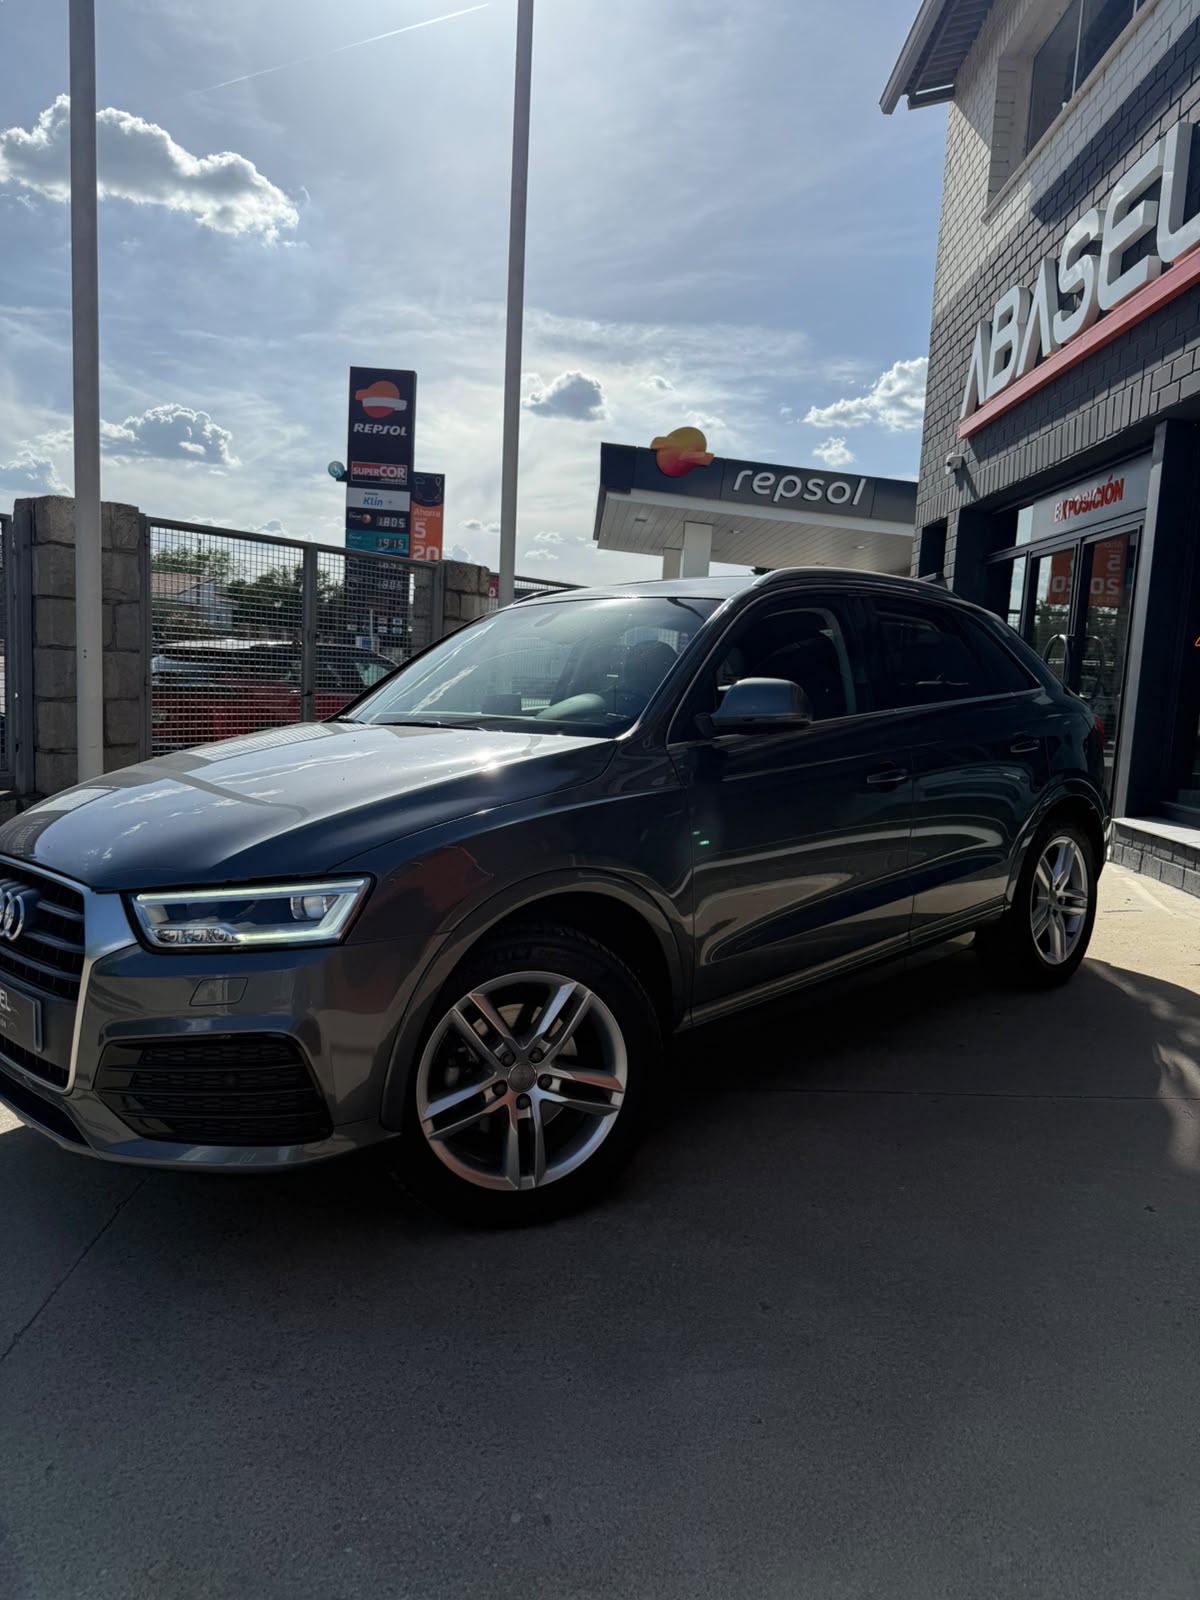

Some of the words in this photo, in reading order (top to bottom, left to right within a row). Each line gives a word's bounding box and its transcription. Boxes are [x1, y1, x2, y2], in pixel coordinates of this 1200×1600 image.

[353, 423, 408, 436] REPSOL
[733, 469, 866, 506] repsol
[1054, 474, 1124, 522] EXPOSICIÓN
[414, 521, 426, 539] 5
